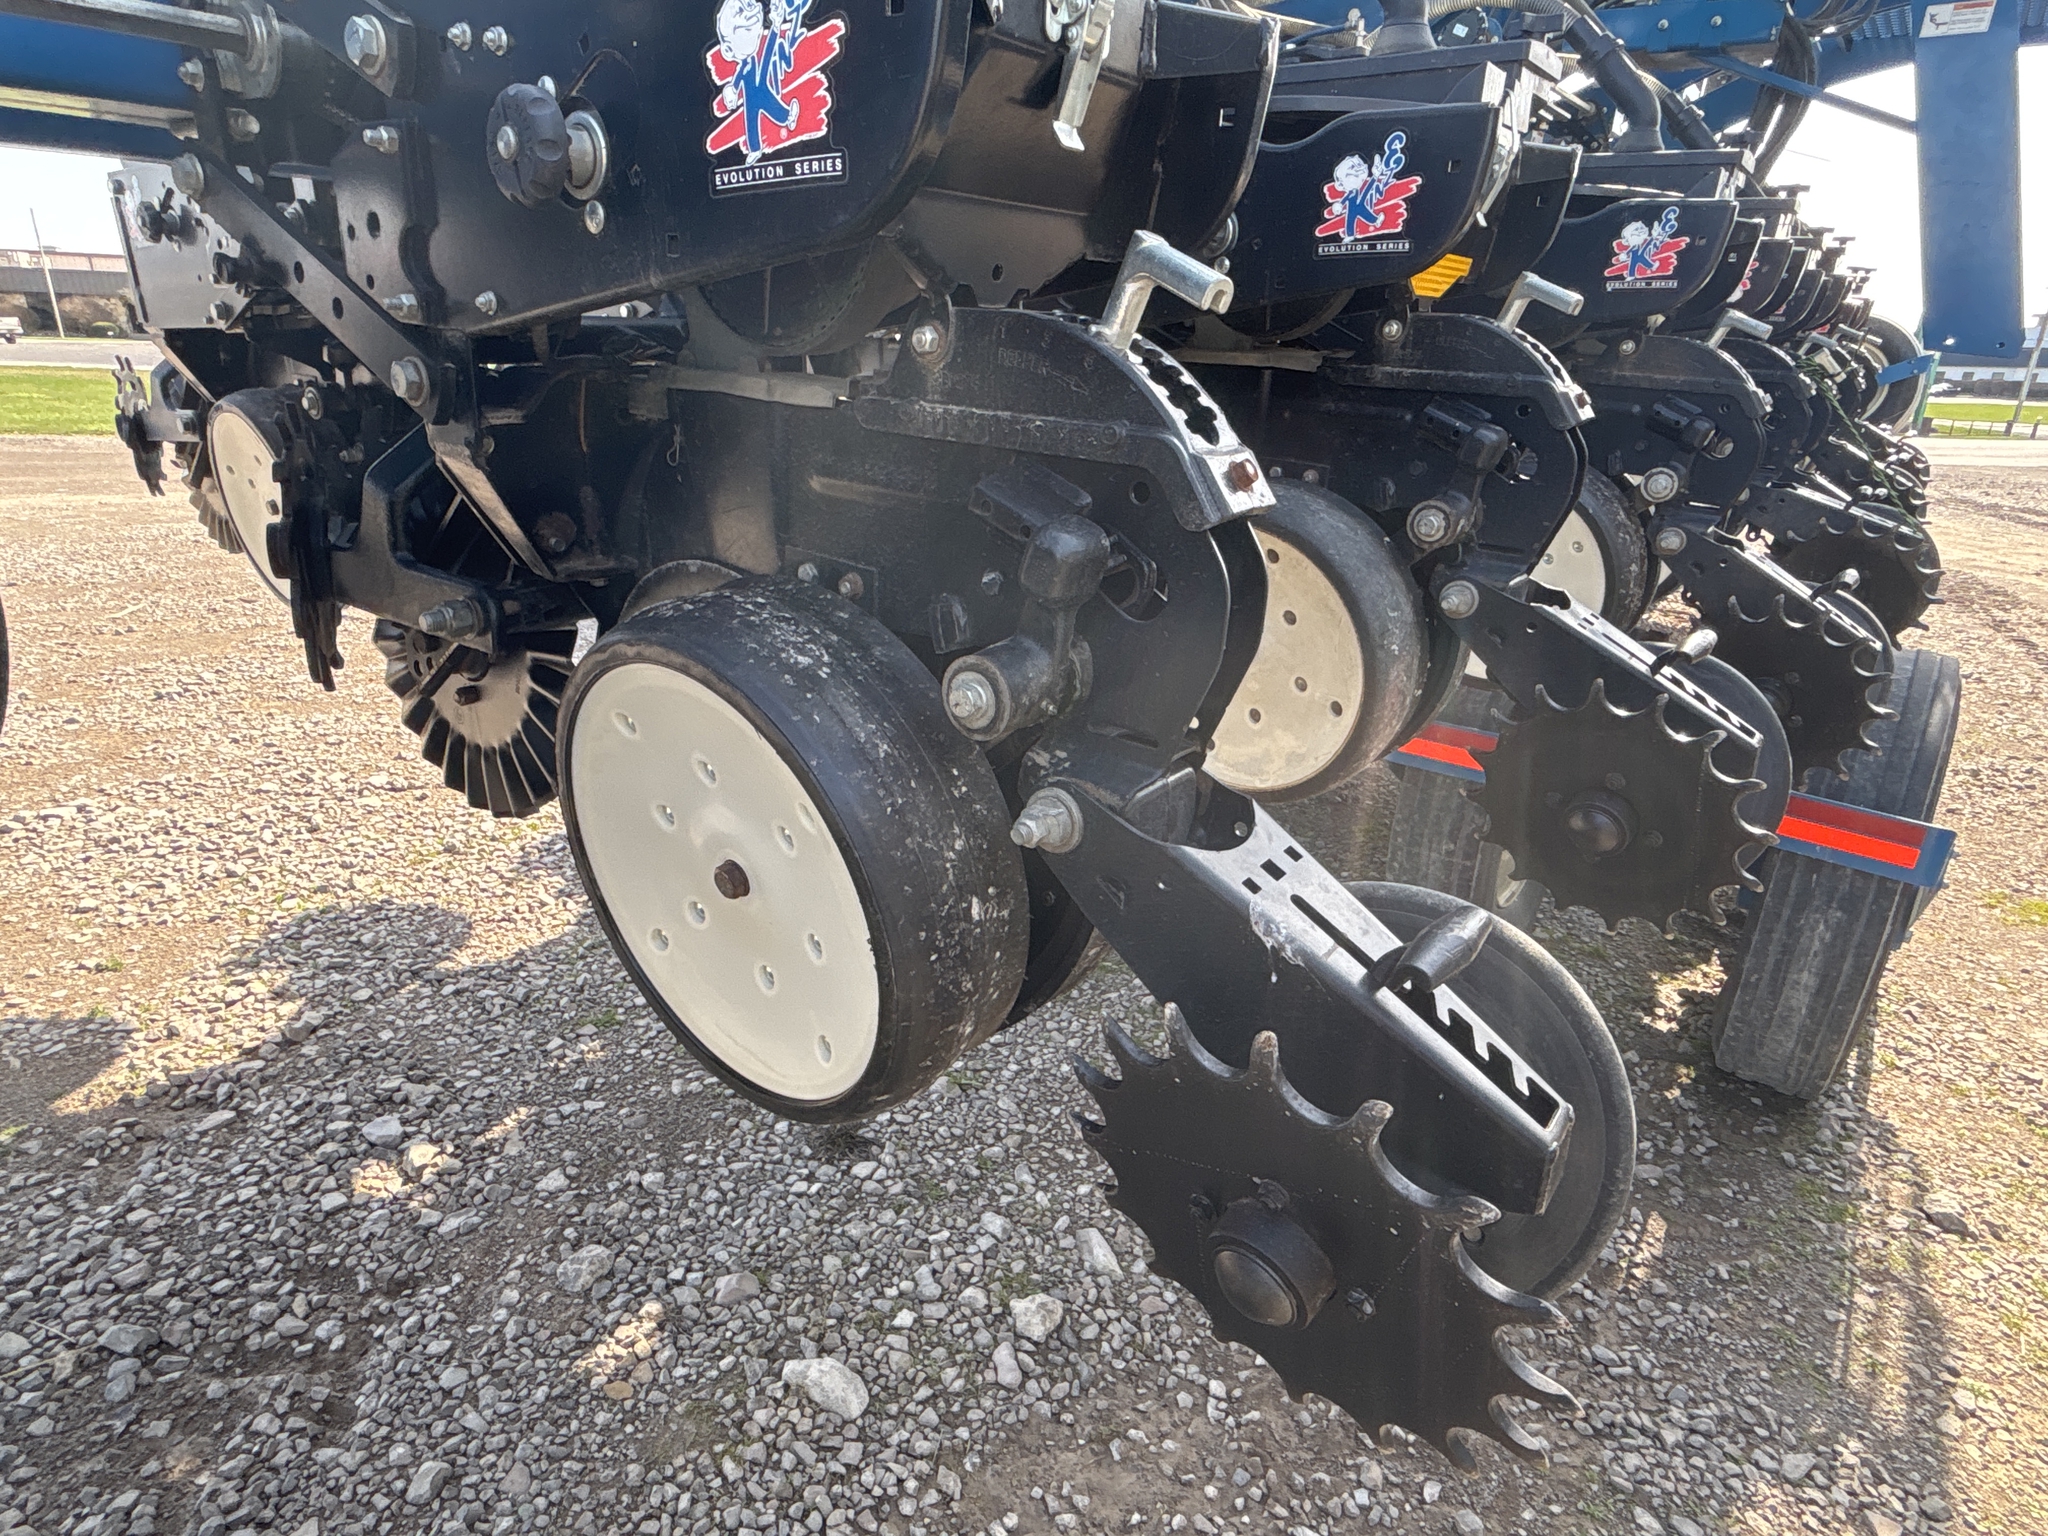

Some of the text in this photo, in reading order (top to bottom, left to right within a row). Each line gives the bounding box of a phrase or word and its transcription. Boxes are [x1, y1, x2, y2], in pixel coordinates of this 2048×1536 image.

[715, 158, 843, 186] EVOLUTION SERIES
[1318, 242, 1410, 253] EVOLUTION SERIES
